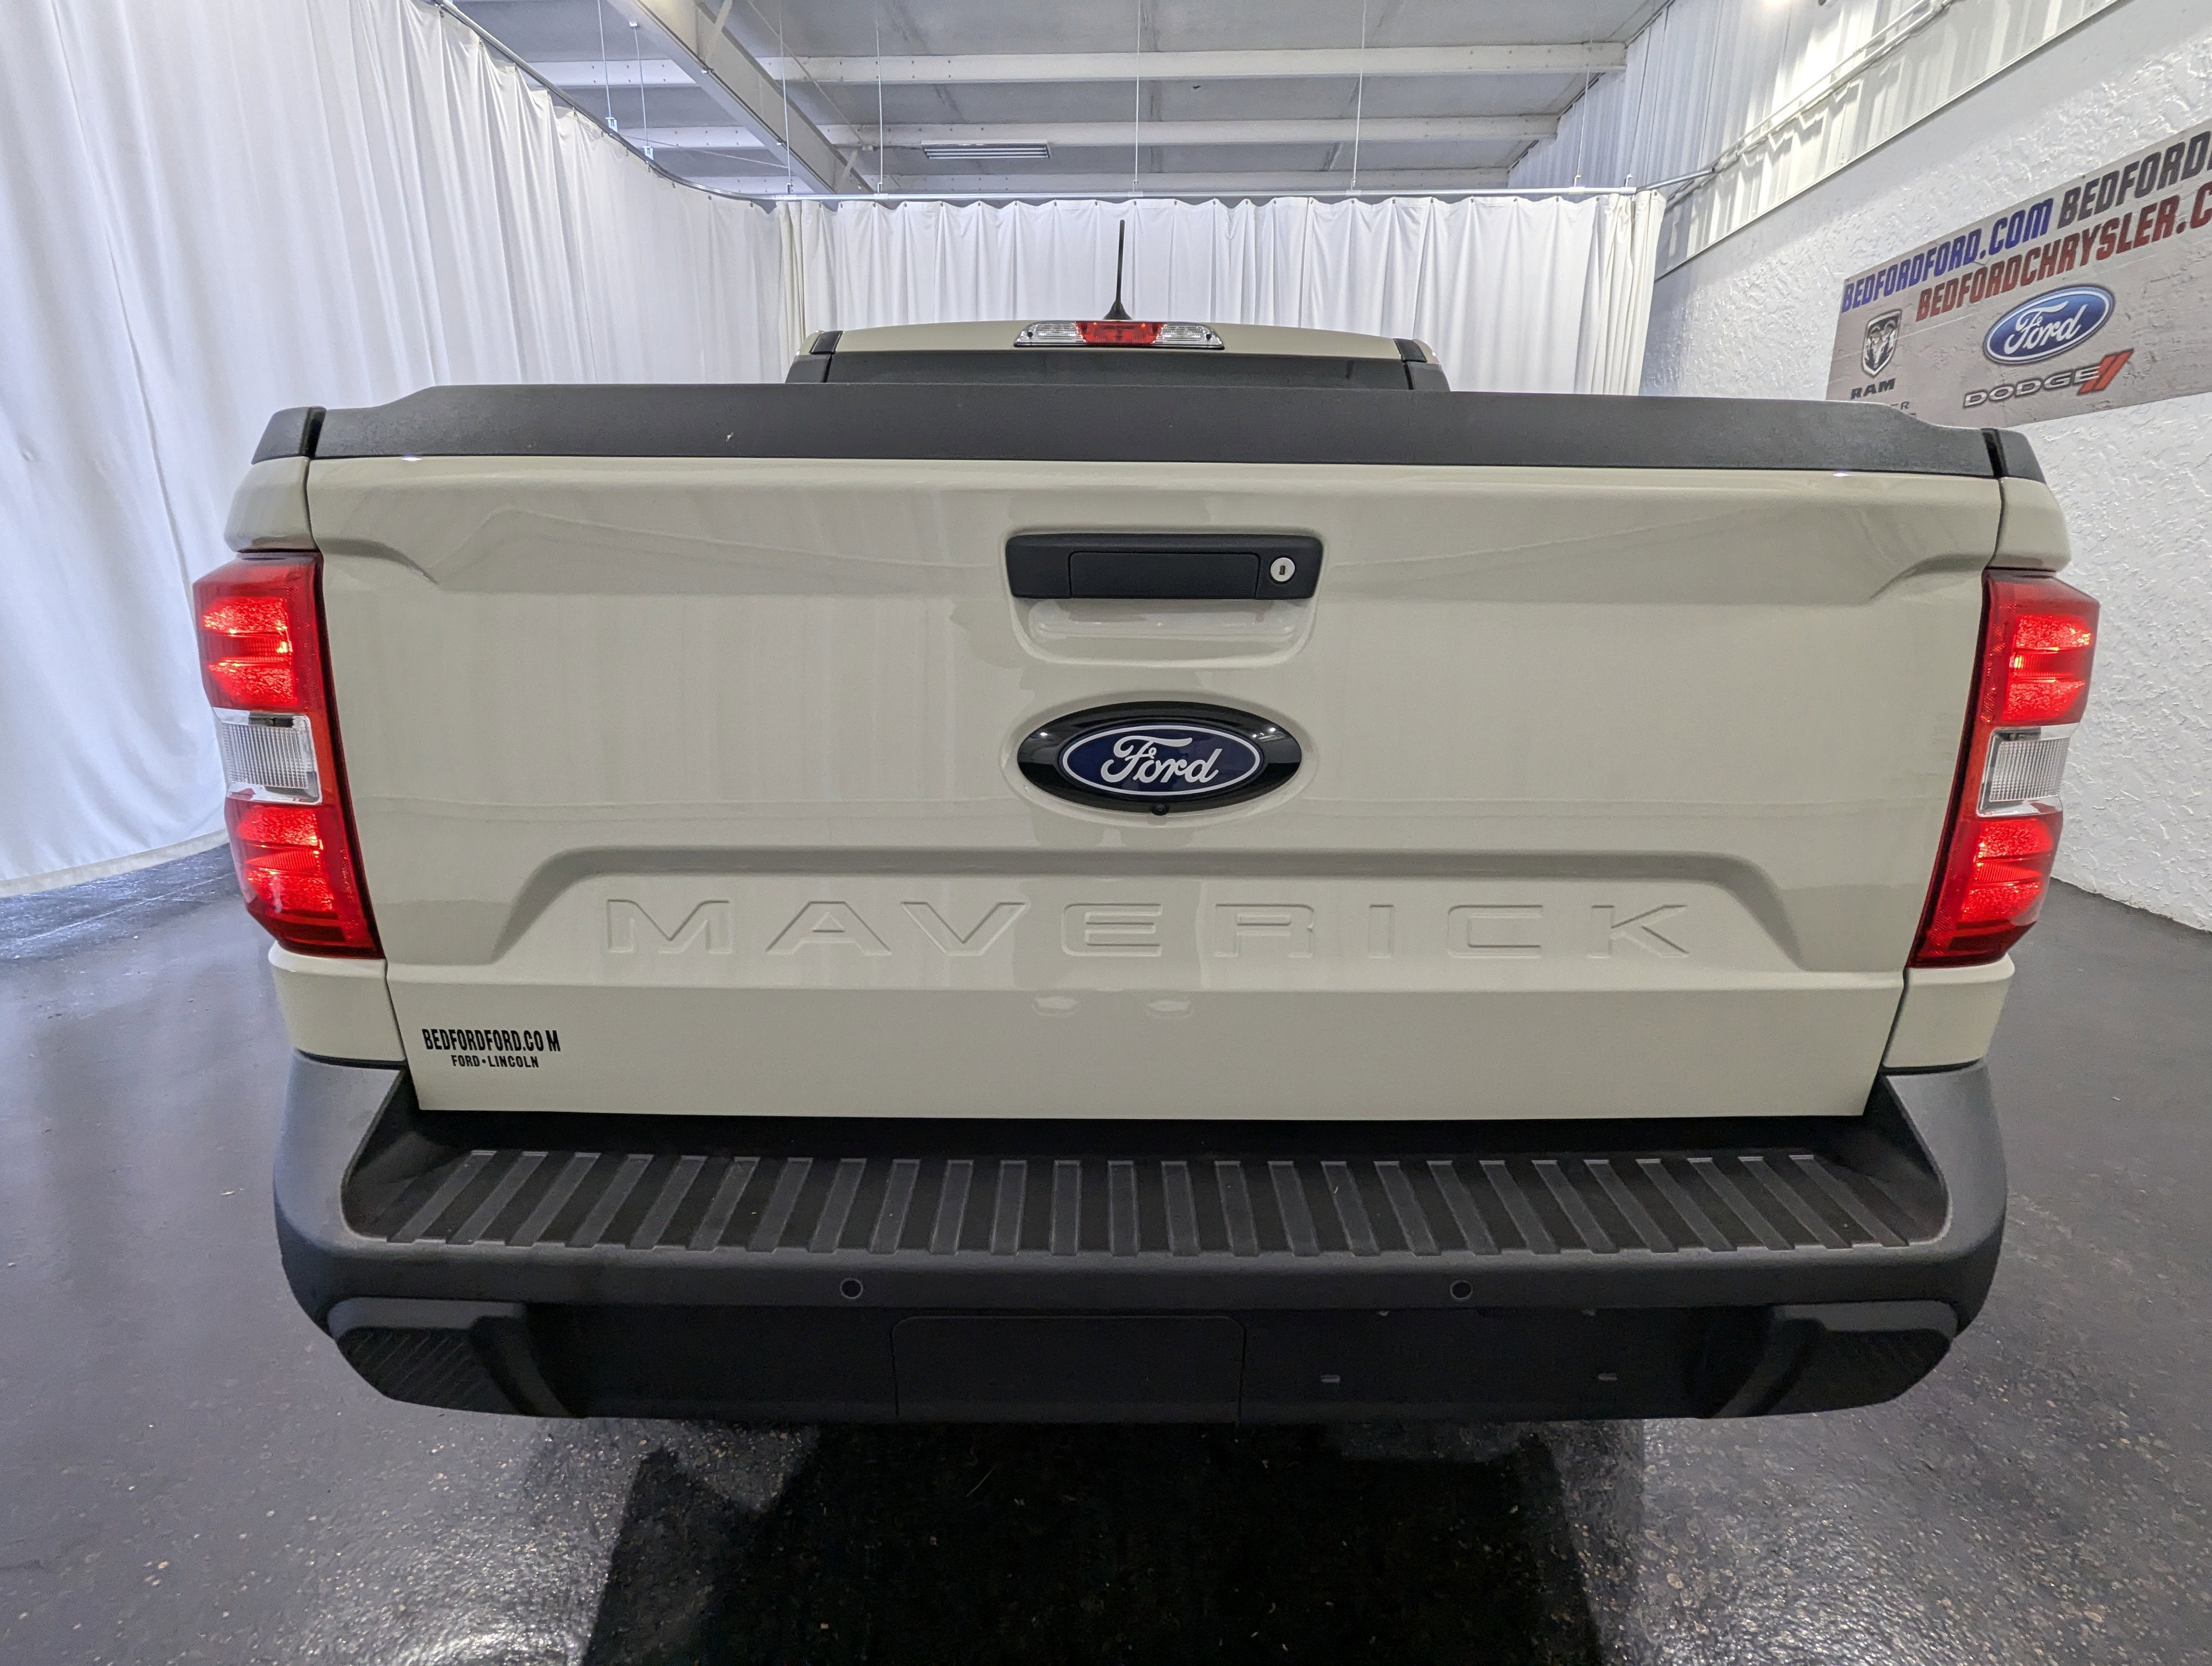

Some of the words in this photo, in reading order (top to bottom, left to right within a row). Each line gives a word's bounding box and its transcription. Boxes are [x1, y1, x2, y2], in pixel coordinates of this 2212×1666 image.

[1841, 197, 2054, 313] BEDFORDFORD.COM
[2057, 131, 2212, 230] BEDFORD
[2003, 301, 2084, 355] Ford
[1850, 378, 1896, 400] RAM
[1962, 364, 2101, 409] DODGE
[1100, 735, 1223, 783] Ford
[606, 898, 1690, 959] MAVERICK
